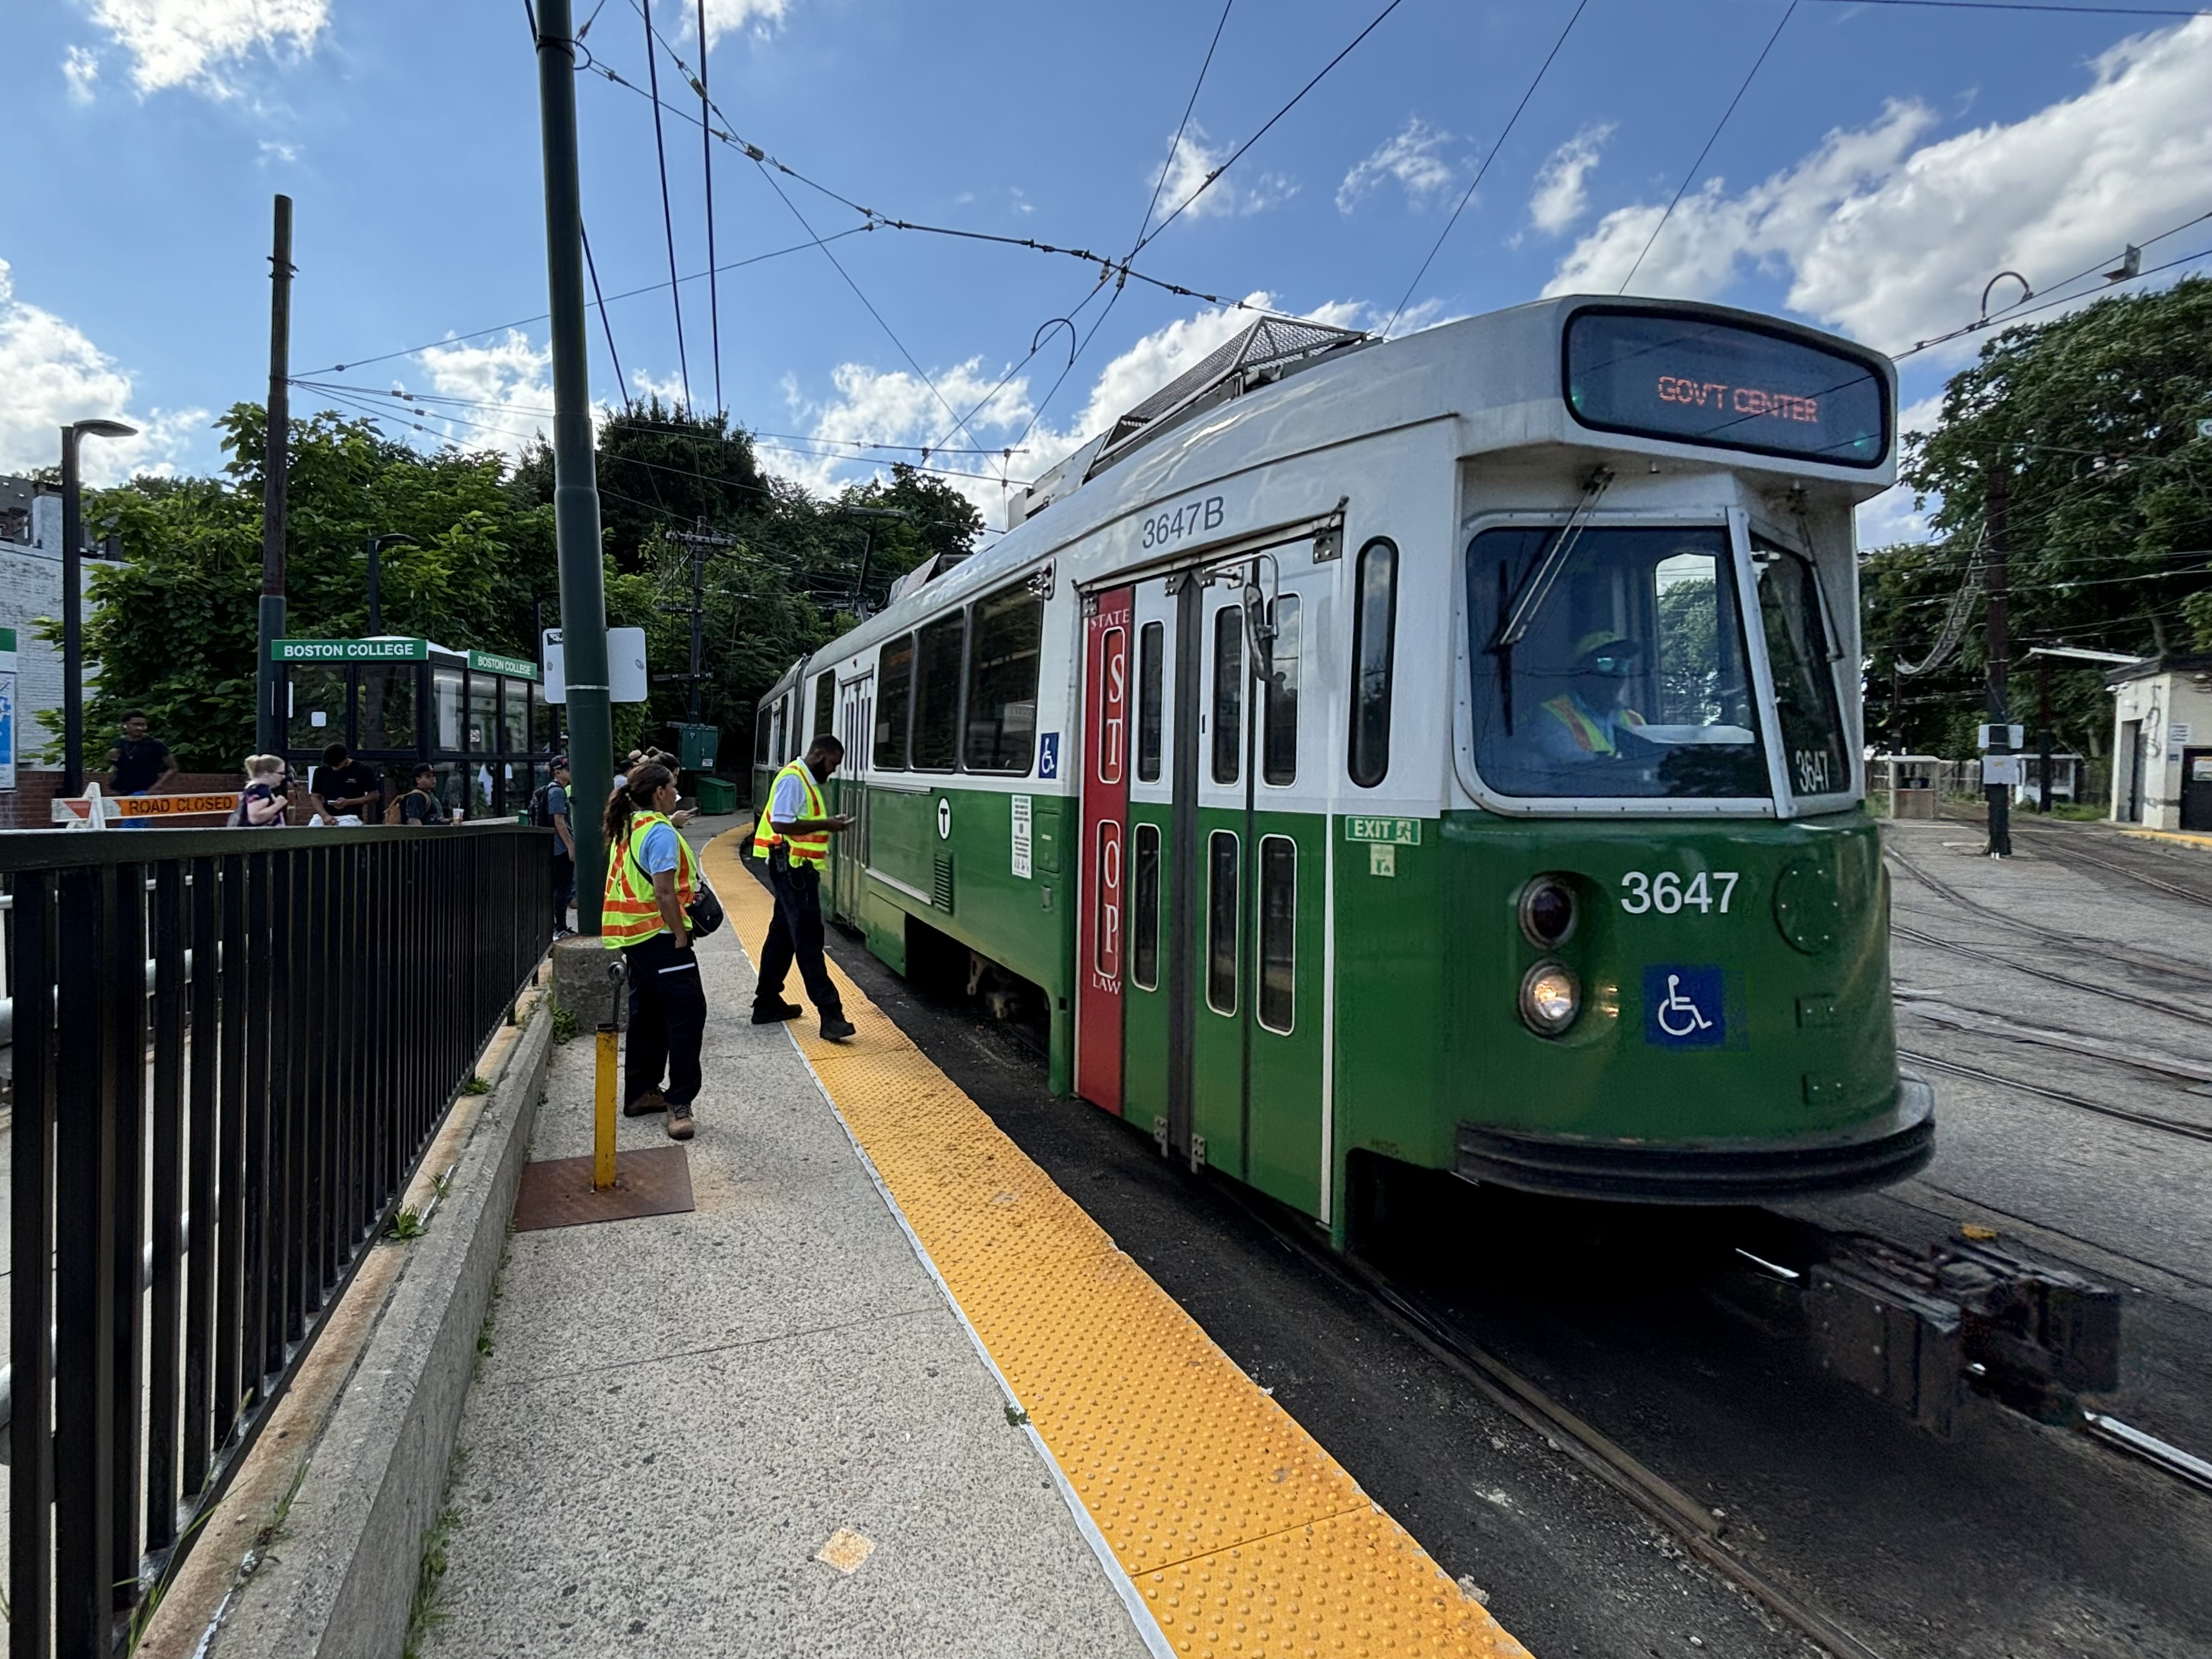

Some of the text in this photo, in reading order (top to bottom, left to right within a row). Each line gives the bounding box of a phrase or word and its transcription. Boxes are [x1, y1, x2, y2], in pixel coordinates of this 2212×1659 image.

[1733, 389, 1818, 422] CENTER
[1142, 496, 1224, 549] 3647B
[1090, 608, 1130, 631] STATE
[284, 644, 414, 657] BOSTON COLLEGE
[477, 656, 532, 676] BOSTON COLLEGE
[1796, 750, 1829, 793] 3647
[129, 796, 232, 814] ROAD CLOSED
[1354, 820, 1391, 838] EXIT
[1621, 871, 1738, 914] 3647
[1092, 973, 1122, 995] LAW
